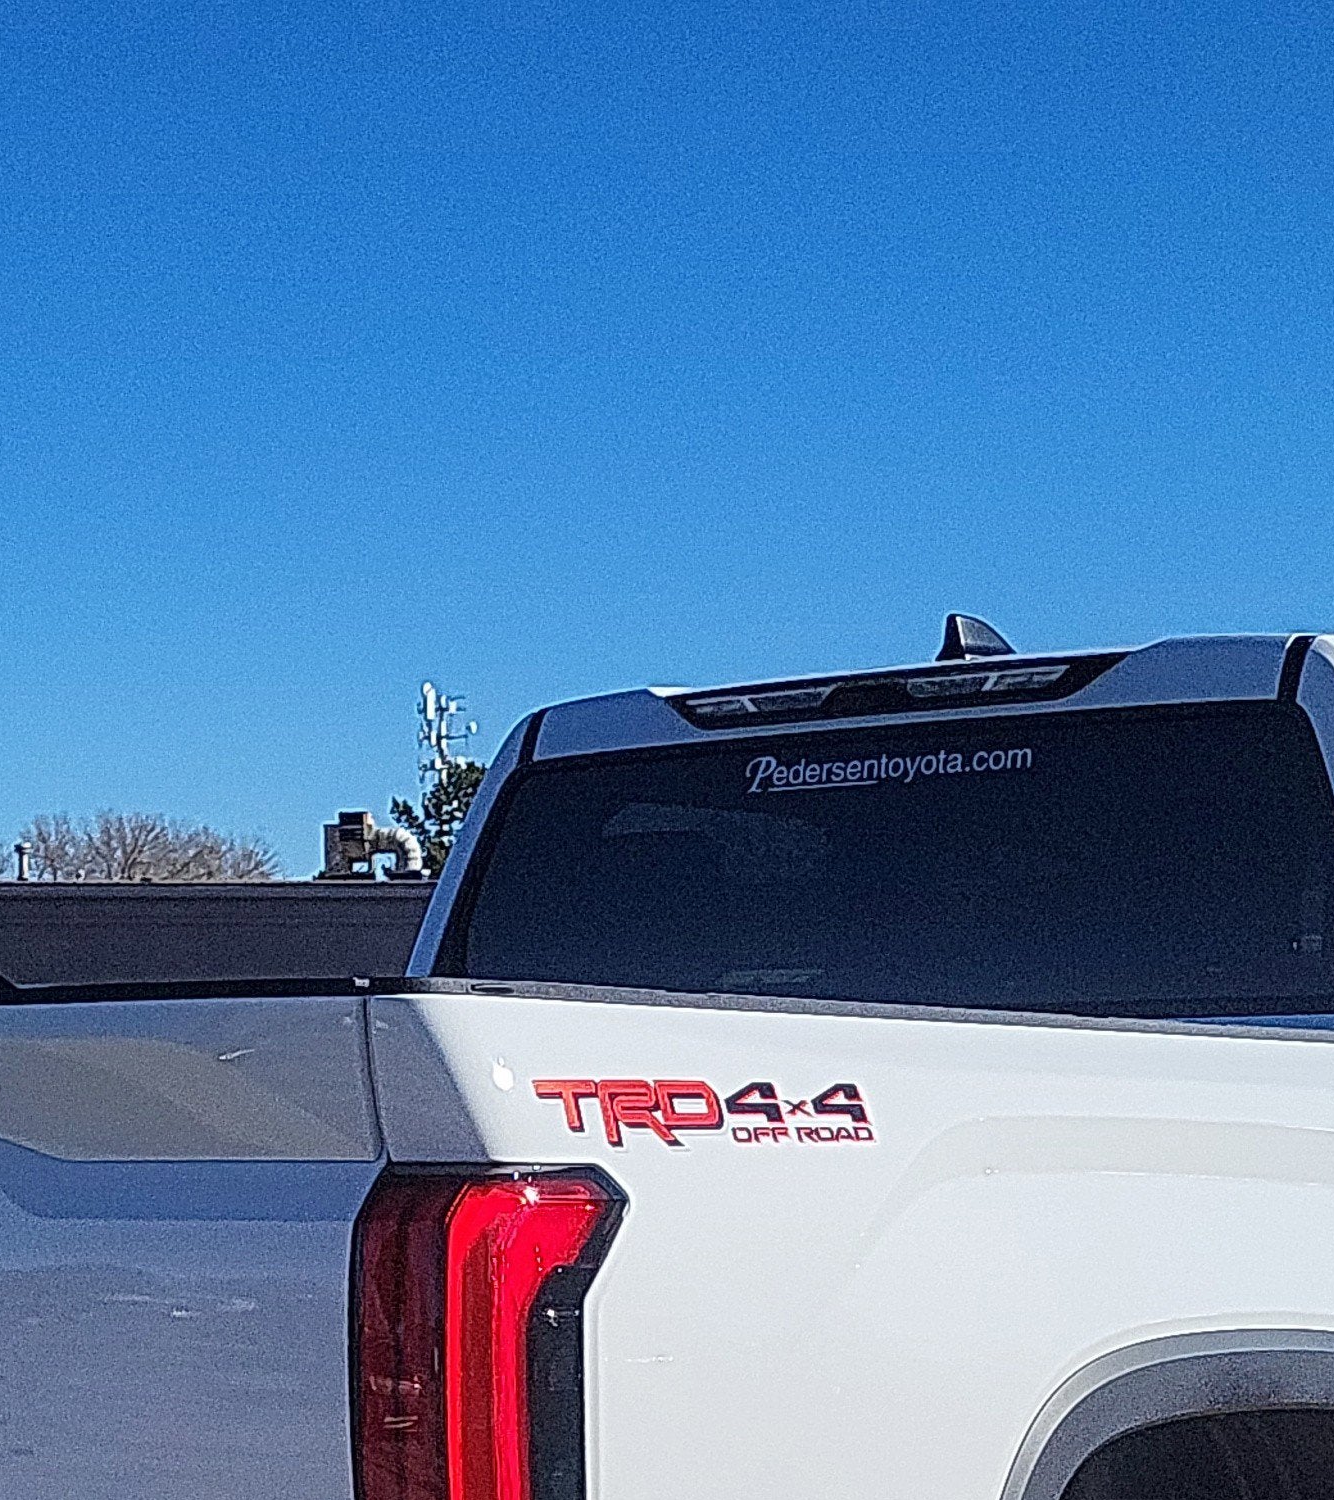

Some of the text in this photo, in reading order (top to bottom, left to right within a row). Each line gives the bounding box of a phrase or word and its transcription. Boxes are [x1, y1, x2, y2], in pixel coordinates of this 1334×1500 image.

[746, 746, 1033, 793] Pedersentoyota.com
[532, 1080, 870, 1148] TRD 4x4
[731, 1126, 874, 1145] OFF ROAD
